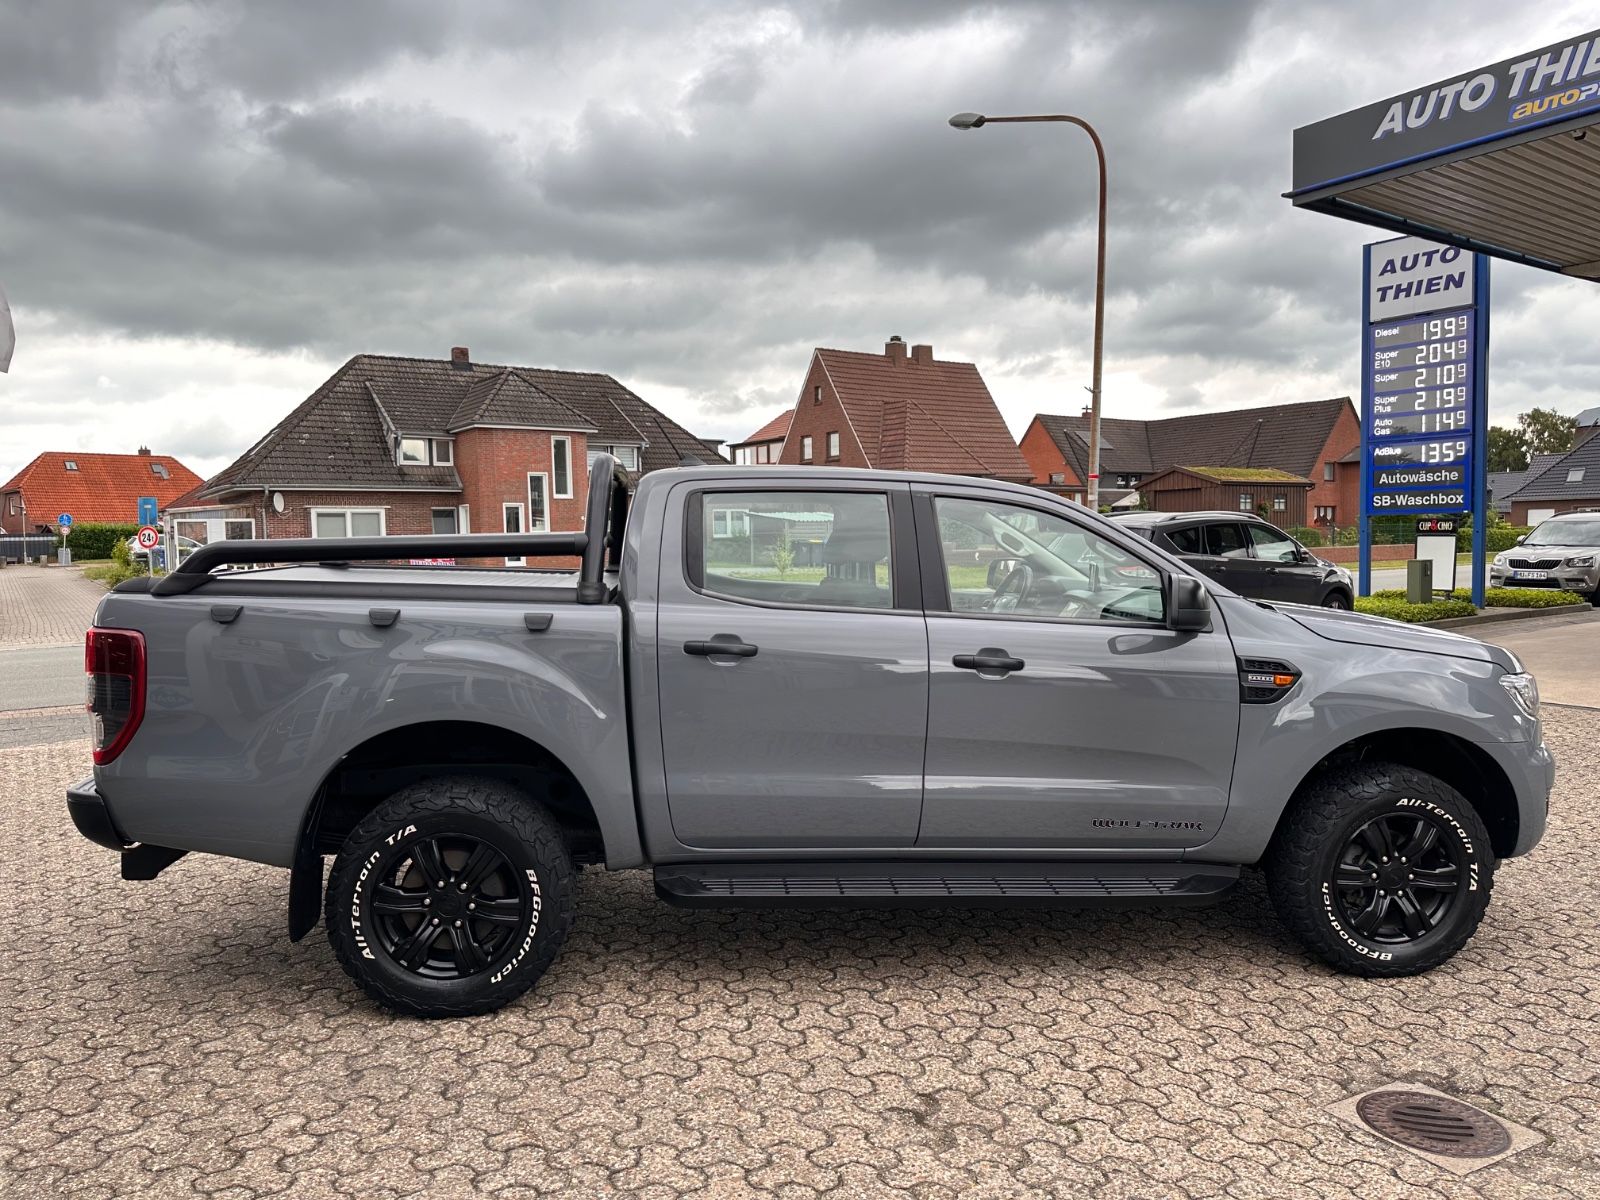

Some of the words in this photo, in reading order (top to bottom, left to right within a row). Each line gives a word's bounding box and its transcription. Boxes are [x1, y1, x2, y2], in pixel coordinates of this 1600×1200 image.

[1372, 73, 1498, 140] AUTO
[1378, 245, 1461, 277] AUTO
[1376, 271, 1466, 303] THIEN
[1374, 326, 1400, 338] Diesel
[1374, 350, 1400, 361] Super
[1374, 360, 1391, 369] E10
[1374, 373, 1399, 384] Super
[1374, 395, 1399, 405] Super
[1374, 404, 1392, 414] Plus
[1374, 418, 1393, 427] Auto
[1373, 427, 1391, 436] Gas
[1373, 446, 1402, 456] AdBlue
[1378, 469, 1459, 484] Autowäsche
[1372, 493, 1464, 507] SB-Waschbox
[1396, 798, 1474, 854] All-Terrain
[1469, 862, 1479, 891] T/A
[351, 851, 381, 960] All-Terrain
[384, 824, 418, 846] T/A
[490, 868, 542, 984] BFGoodrich
[1321, 882, 1393, 961] BFGoodrich
